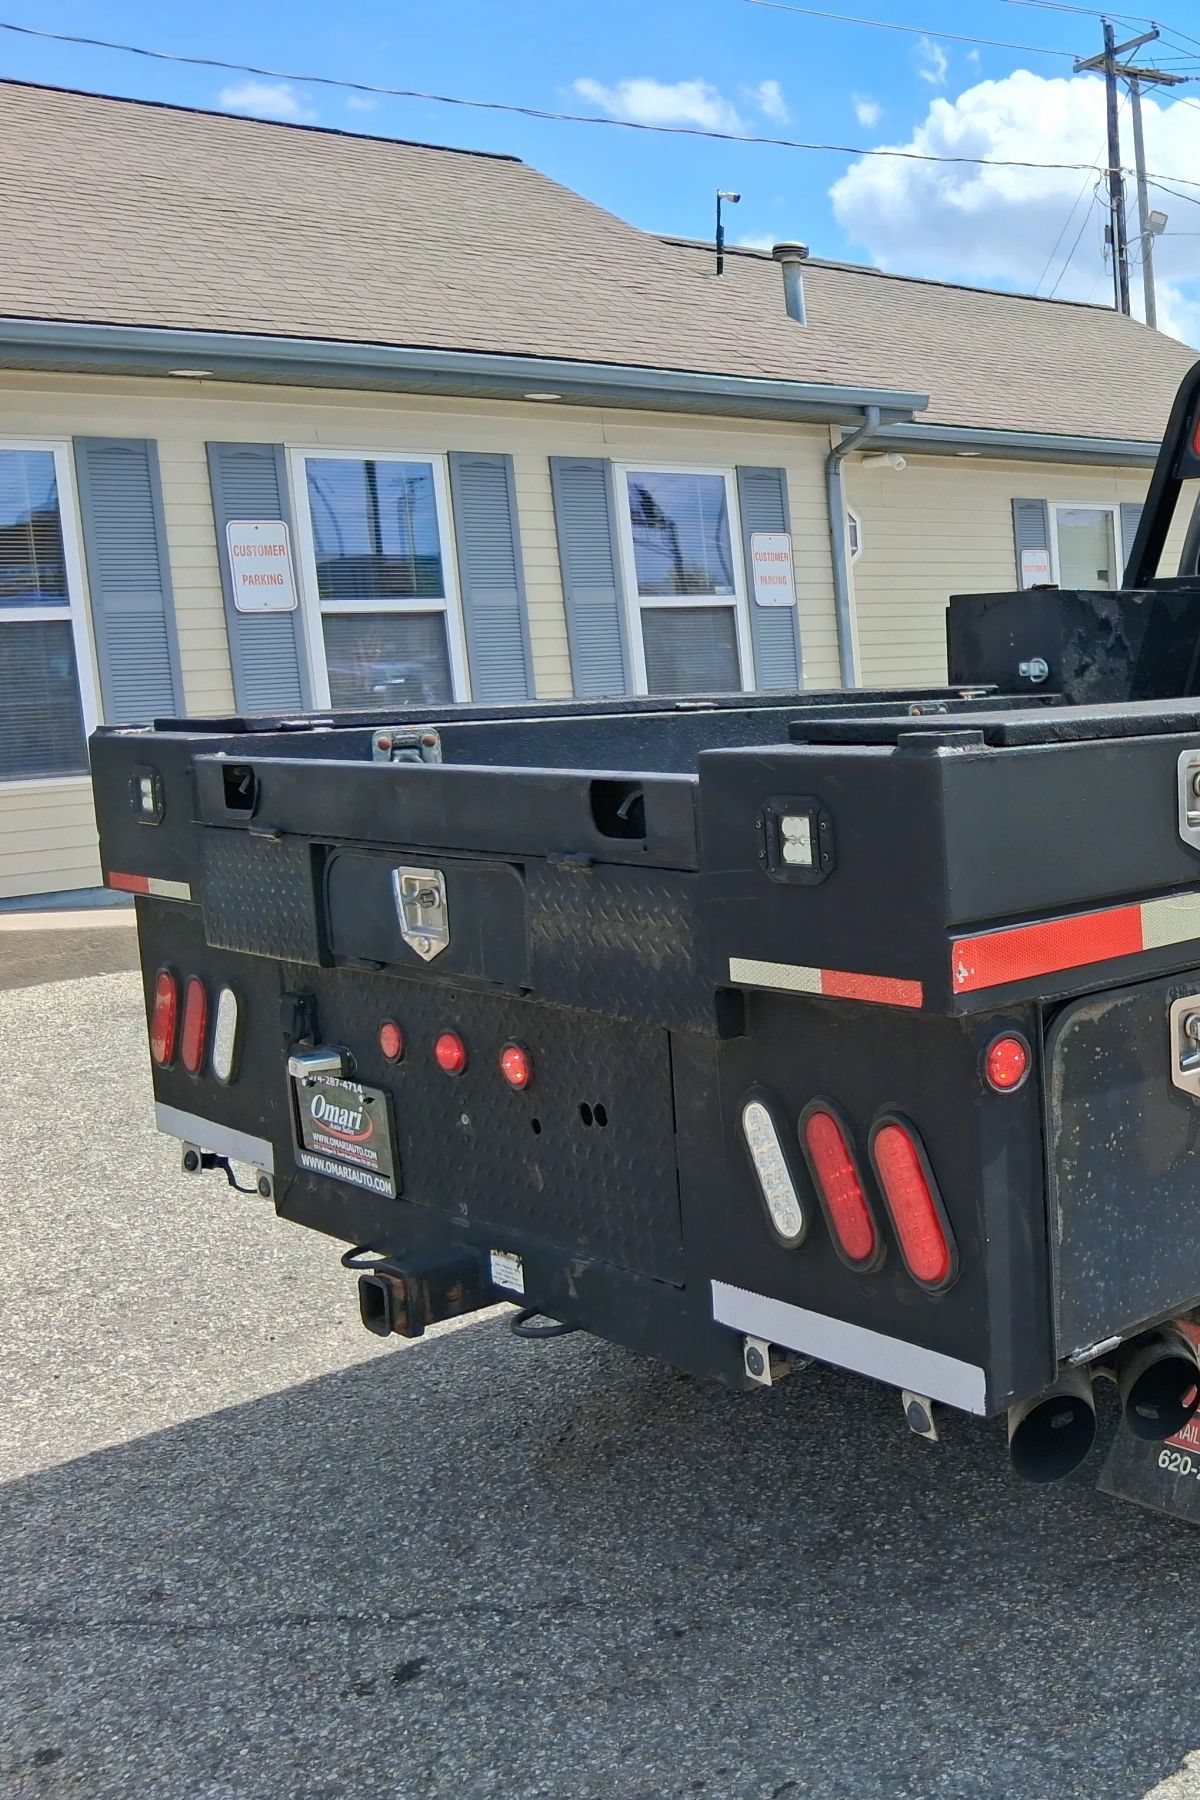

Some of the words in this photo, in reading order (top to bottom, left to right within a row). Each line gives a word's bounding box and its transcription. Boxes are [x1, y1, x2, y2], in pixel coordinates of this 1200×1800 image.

[233, 544, 286, 557] CUSTOMER
[755, 551, 789, 562] CUSTOMER
[242, 574, 284, 586] PARKING
[760, 575, 787, 585] PARKING
[311, 1094, 363, 1130] Omari
[312, 1132, 378, 1161] WWW.OMARIAUTO.COM
[301, 1153, 392, 1195] WWW.OMARIAUTO.COM
